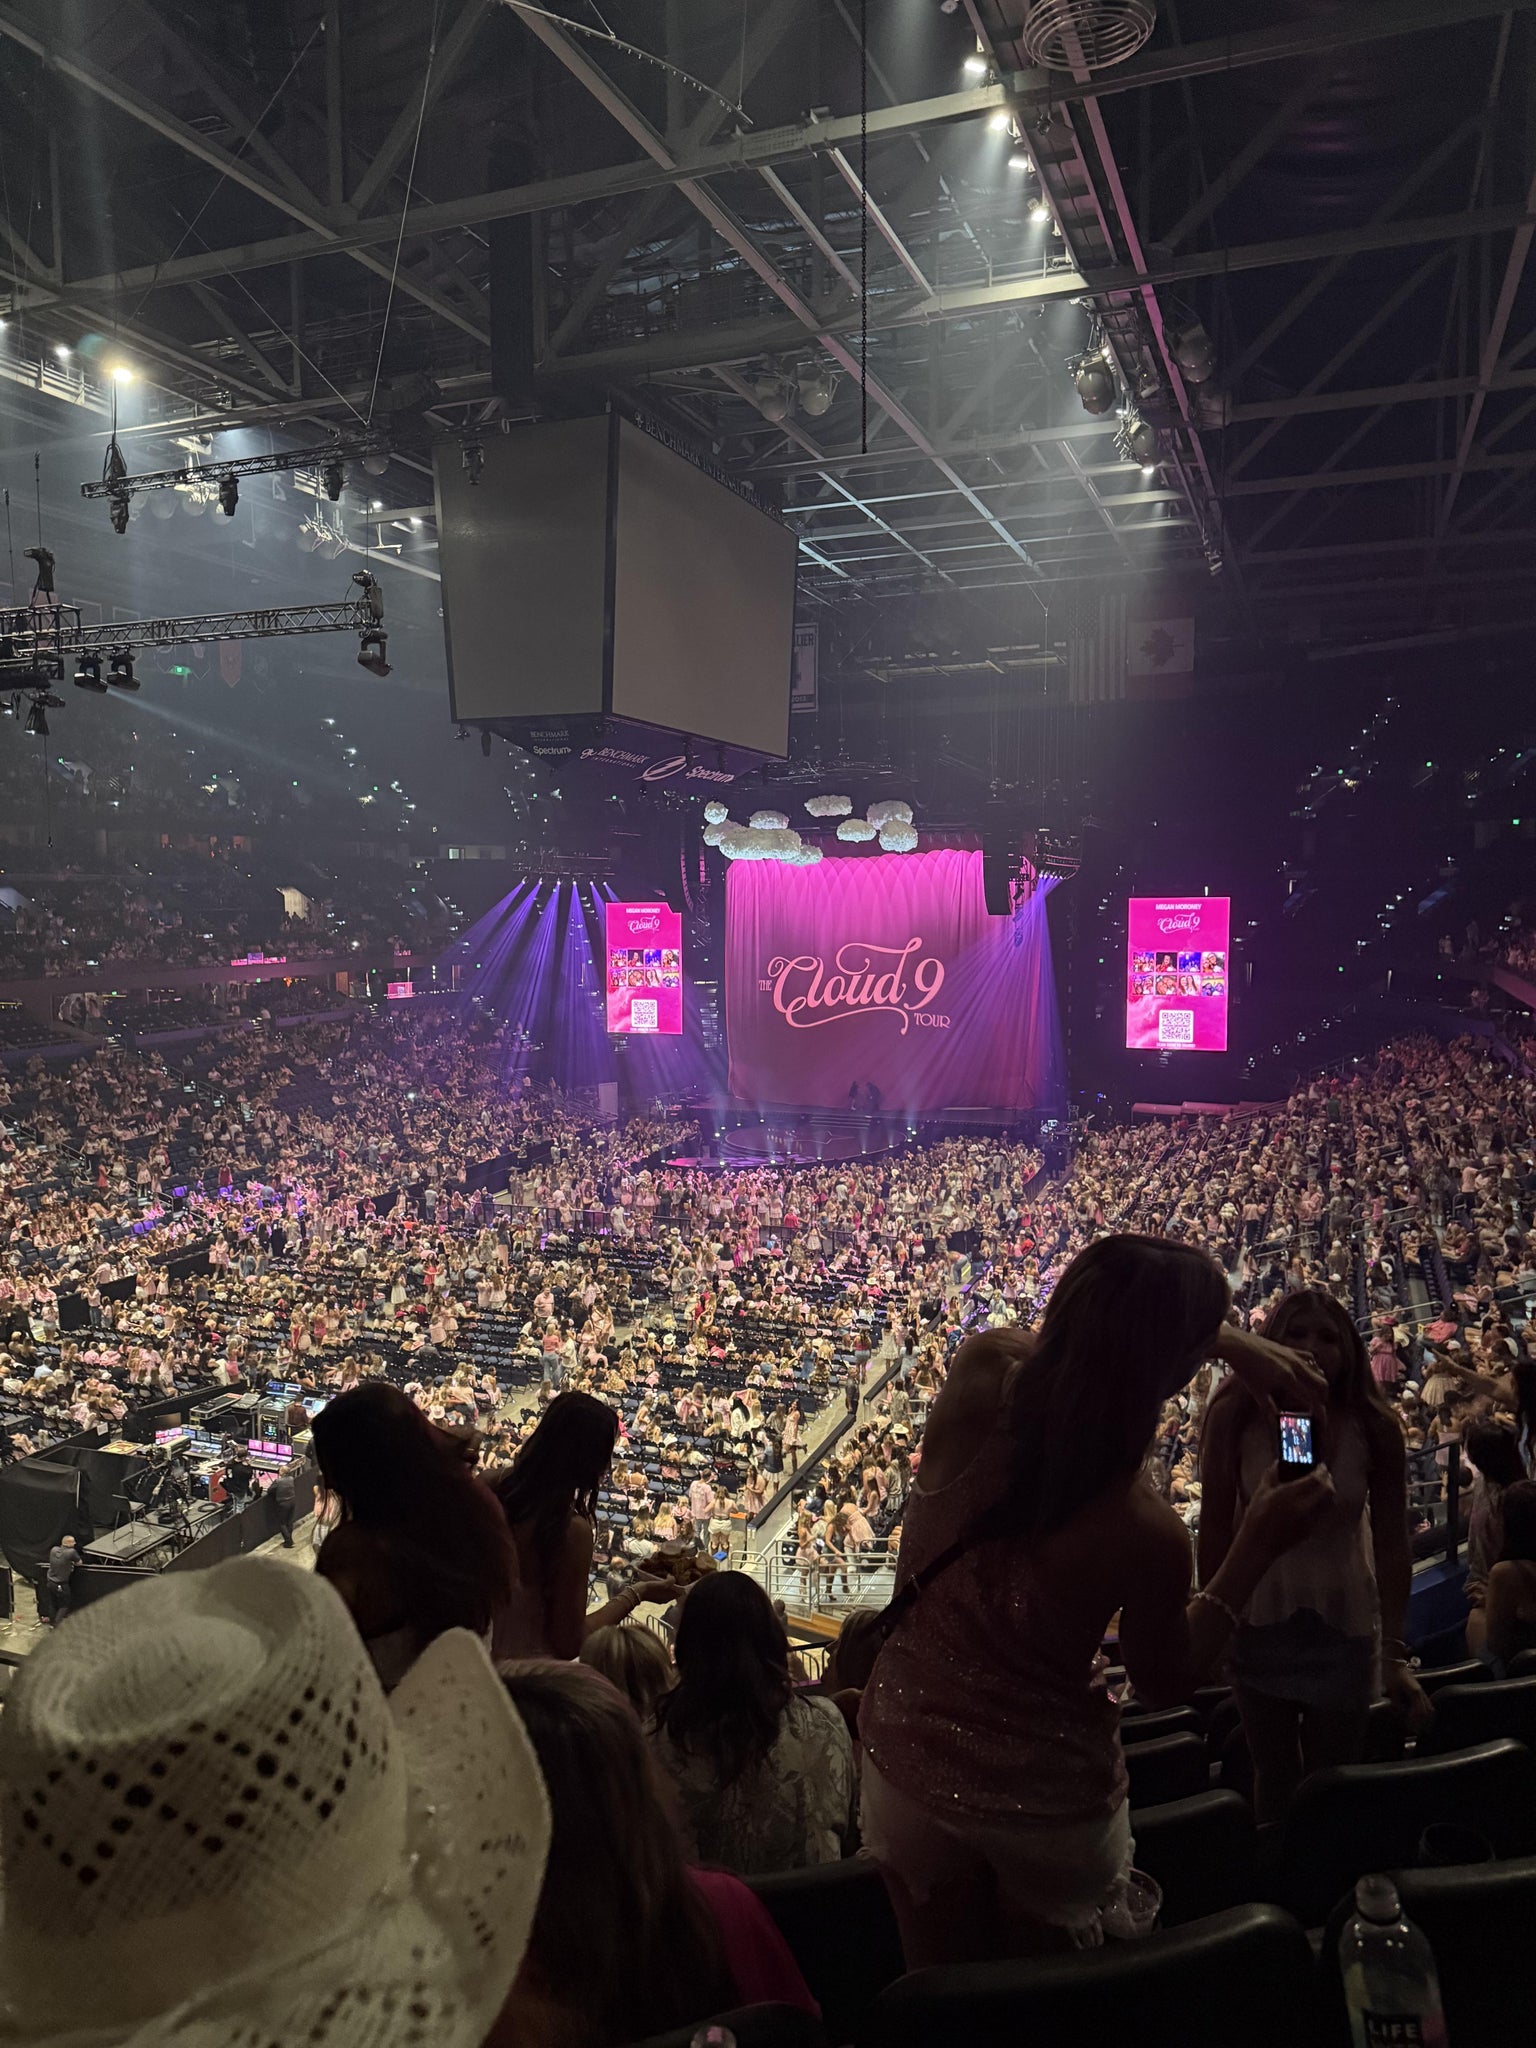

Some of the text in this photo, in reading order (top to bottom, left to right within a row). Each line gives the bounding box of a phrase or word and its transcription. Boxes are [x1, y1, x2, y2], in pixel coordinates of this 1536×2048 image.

[645, 416, 701, 467] BENCHMARK
[533, 745, 568, 756] Spectrum
[685, 766, 735, 783] Spectrum
[628, 915, 656, 934] Cloud
[1158, 912, 1201, 934] Cloud 9
[758, 980, 772, 991] THE
[767, 937, 945, 1035] Cloud 9
[914, 1012, 951, 1029] TOUR
[1368, 2019, 1418, 2039] LIFE
